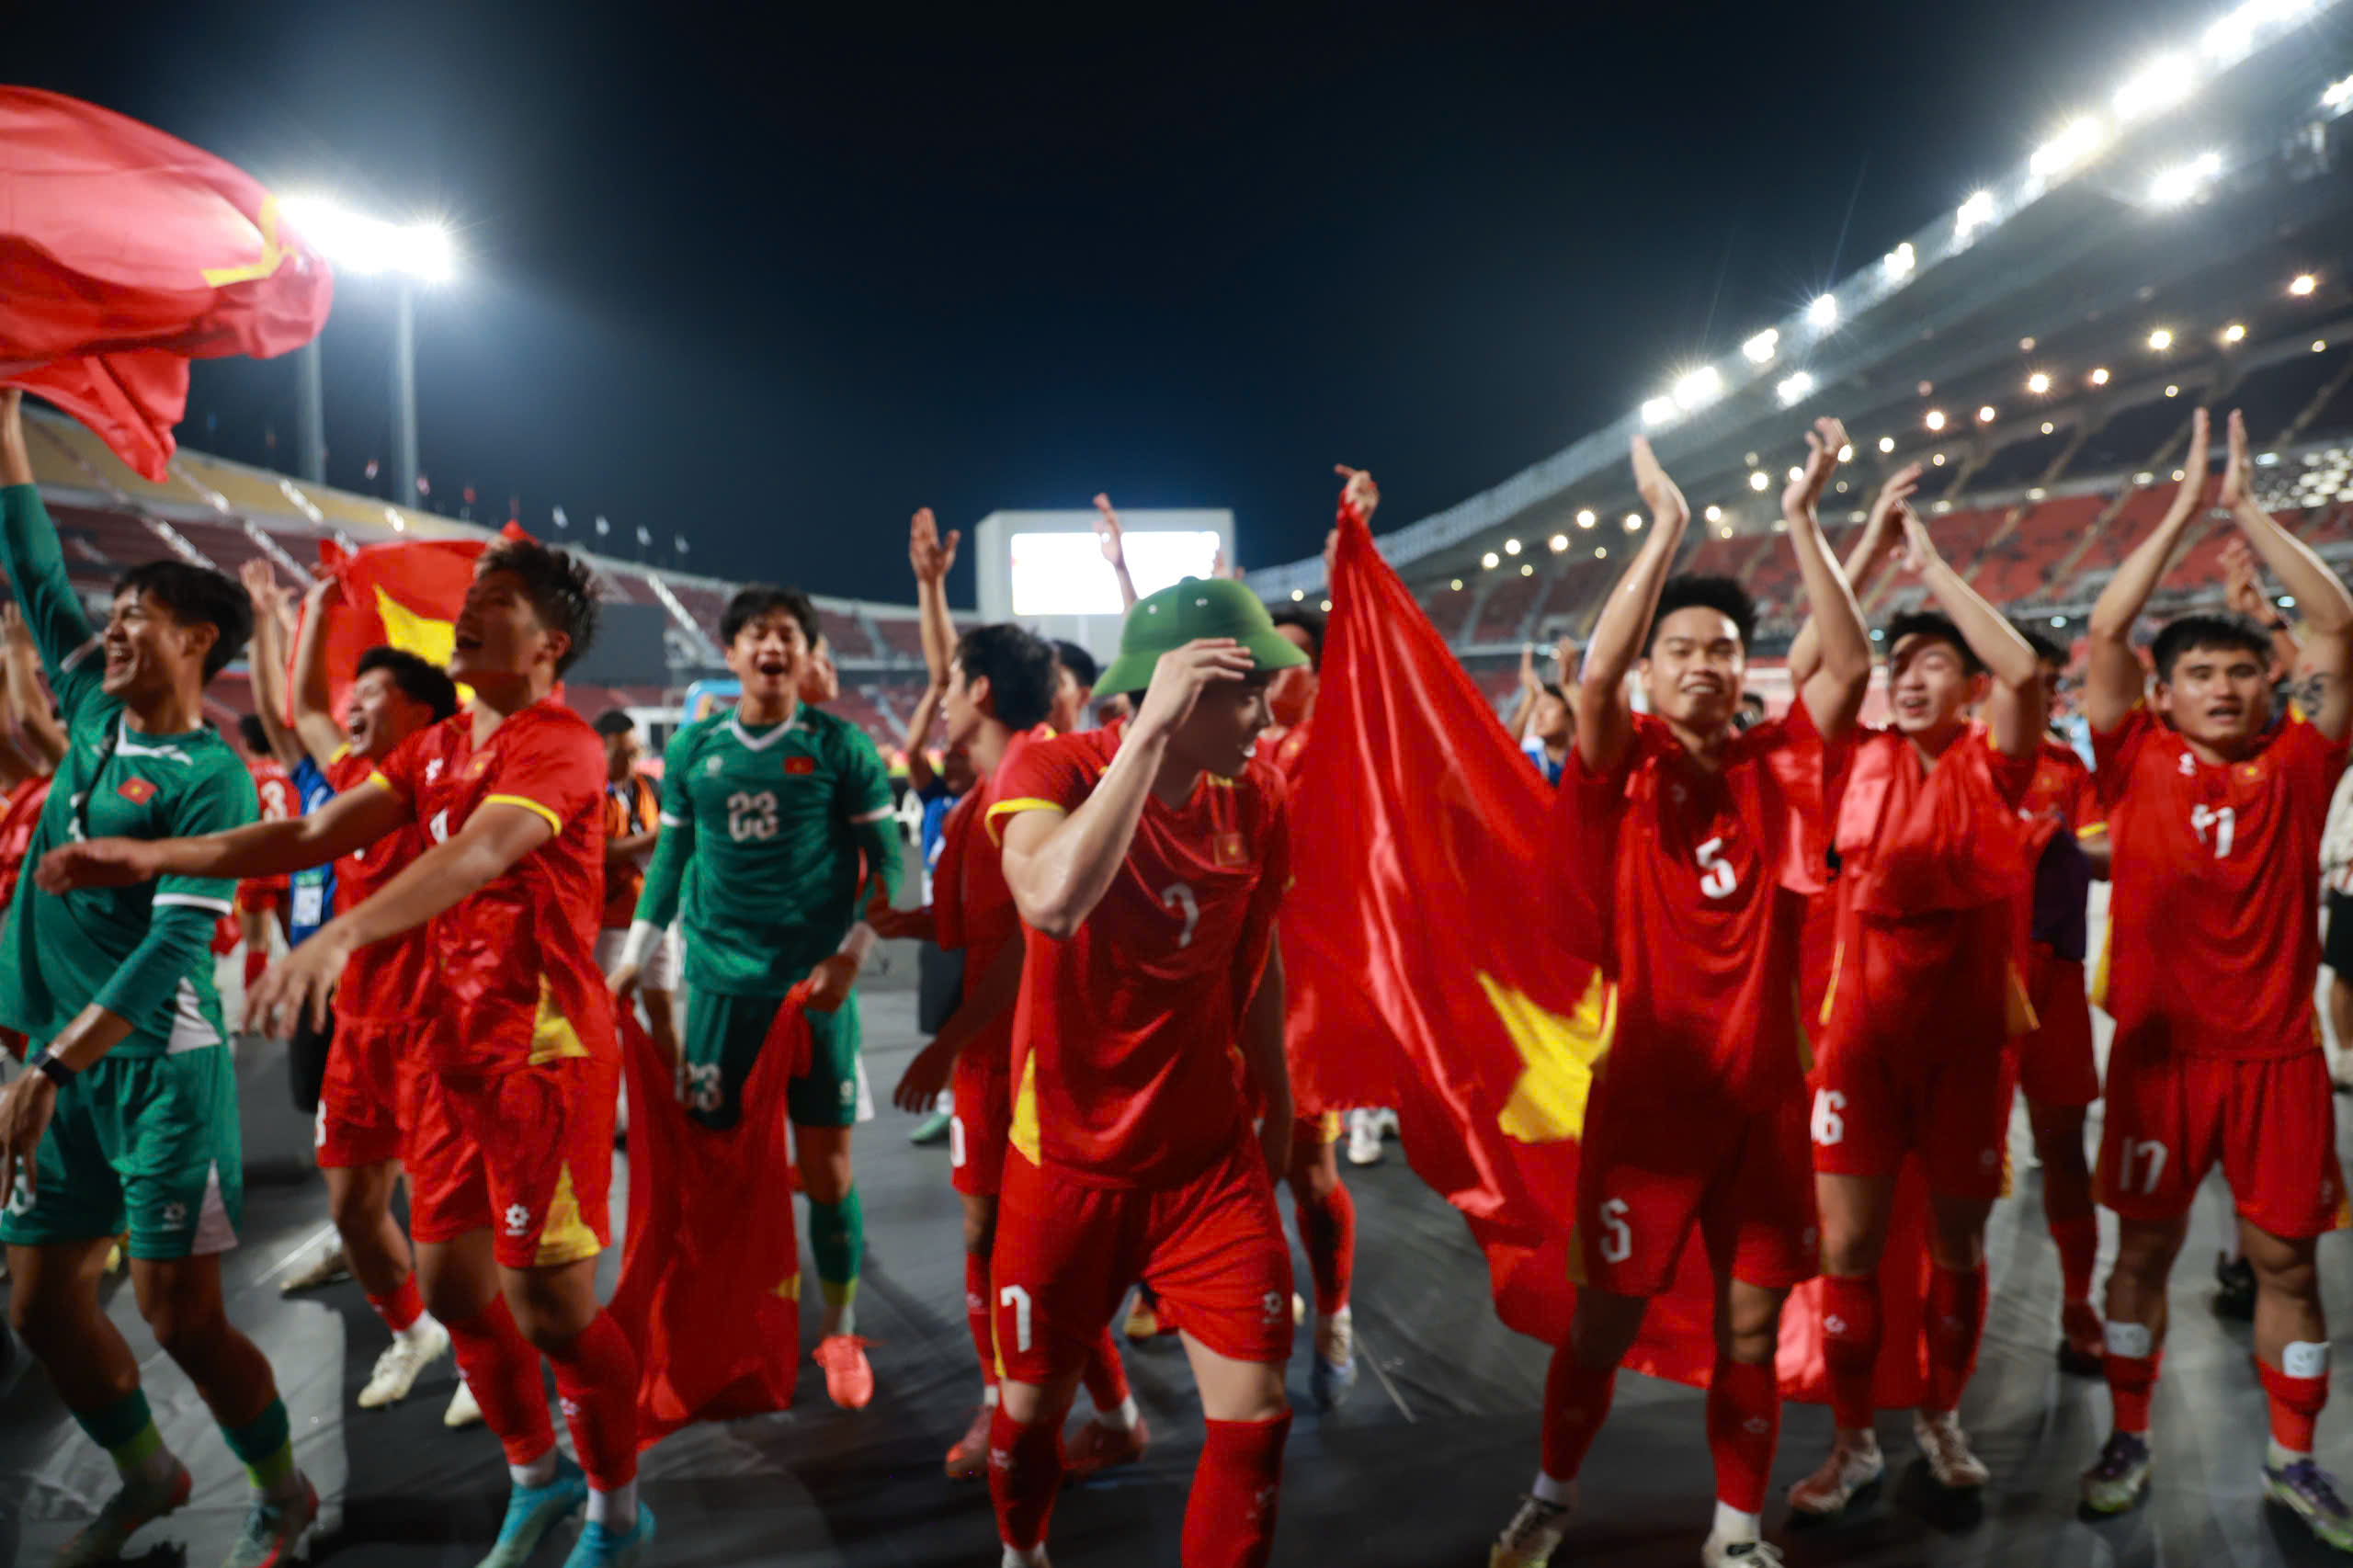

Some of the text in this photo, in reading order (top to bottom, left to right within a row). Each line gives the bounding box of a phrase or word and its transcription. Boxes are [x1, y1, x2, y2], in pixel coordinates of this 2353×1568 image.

[727, 790, 779, 842] 23
[1695, 835, 1737, 899] 5
[2119, 1136, 2169, 1194] 17
[1599, 1197, 1631, 1264] 5
[1000, 1284, 1031, 1352] 7
